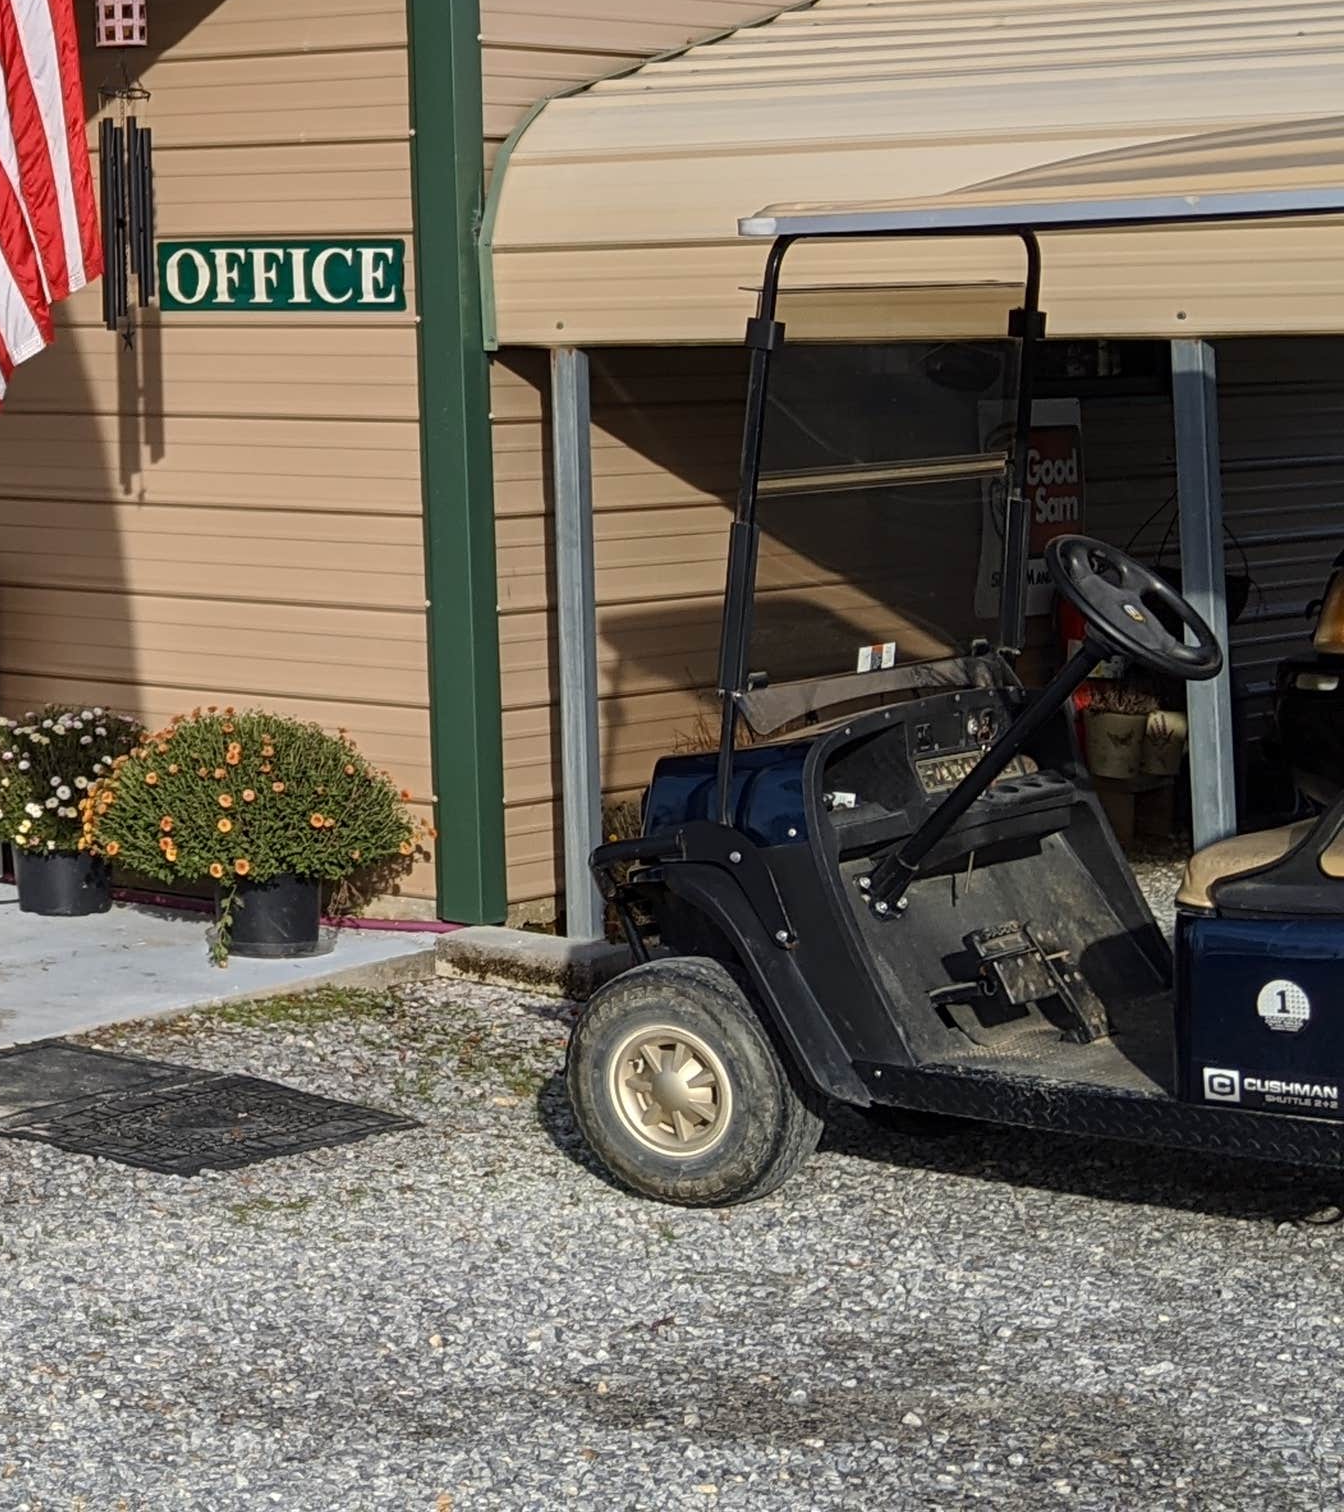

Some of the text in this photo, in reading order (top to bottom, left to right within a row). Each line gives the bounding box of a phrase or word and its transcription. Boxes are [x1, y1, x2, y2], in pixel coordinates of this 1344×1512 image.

[165, 247, 396, 304] OFFICE
[1025, 447, 1078, 486] Good
[1035, 487, 1080, 524] Sam
[1275, 989, 1291, 1014] 1
[1243, 1077, 1339, 1100] CUSHMAN
[1264, 1094, 1339, 1111] SHUTTLE 2+2
